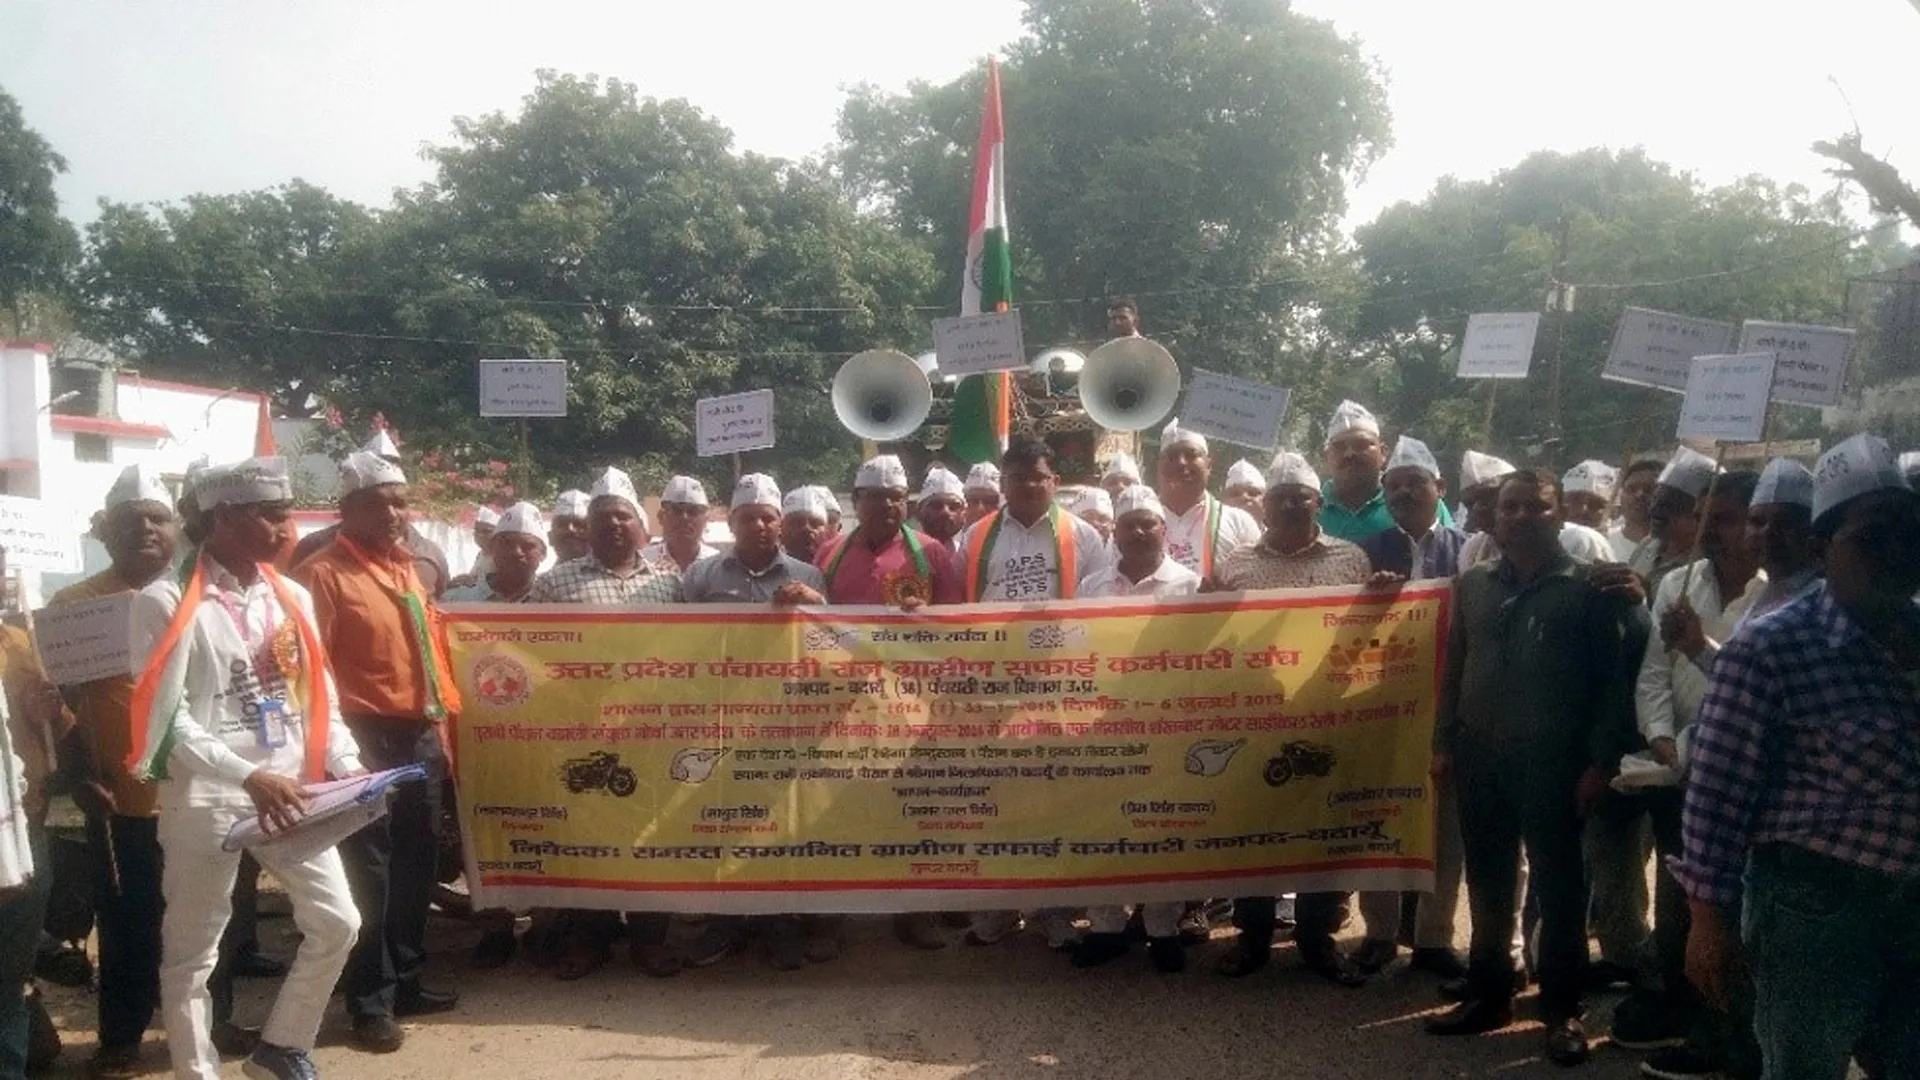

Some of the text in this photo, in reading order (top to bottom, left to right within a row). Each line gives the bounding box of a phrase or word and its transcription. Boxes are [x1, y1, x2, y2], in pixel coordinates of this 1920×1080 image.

[544, 660, 615, 681] उत्तर
[620, 656, 699, 682] प्रदेश
[706, 655, 821, 680] पंचायती
[828, 660, 885, 679] राज
[892, 655, 996, 678] ग्रामीण
[1003, 653, 1099, 677] सफाई
[1106, 648, 1235, 674] कर्मचारी
[1243, 644, 1302, 669] संघ
[782, 681, 831, 695] जनपद
[893, 676, 922, 699] (38)
[982, 681, 1009, 695] राज
[1013, 677, 1063, 695] विभाग
[601, 703, 662, 717] शासन
[632, 845, 723, 860] समस्त
[731, 840, 862, 859] सम्मानित
[868, 838, 966, 859] ग्रामीण
[973, 838, 1063, 858] सफाई
[1069, 836, 1185, 856] कर्मचारी
